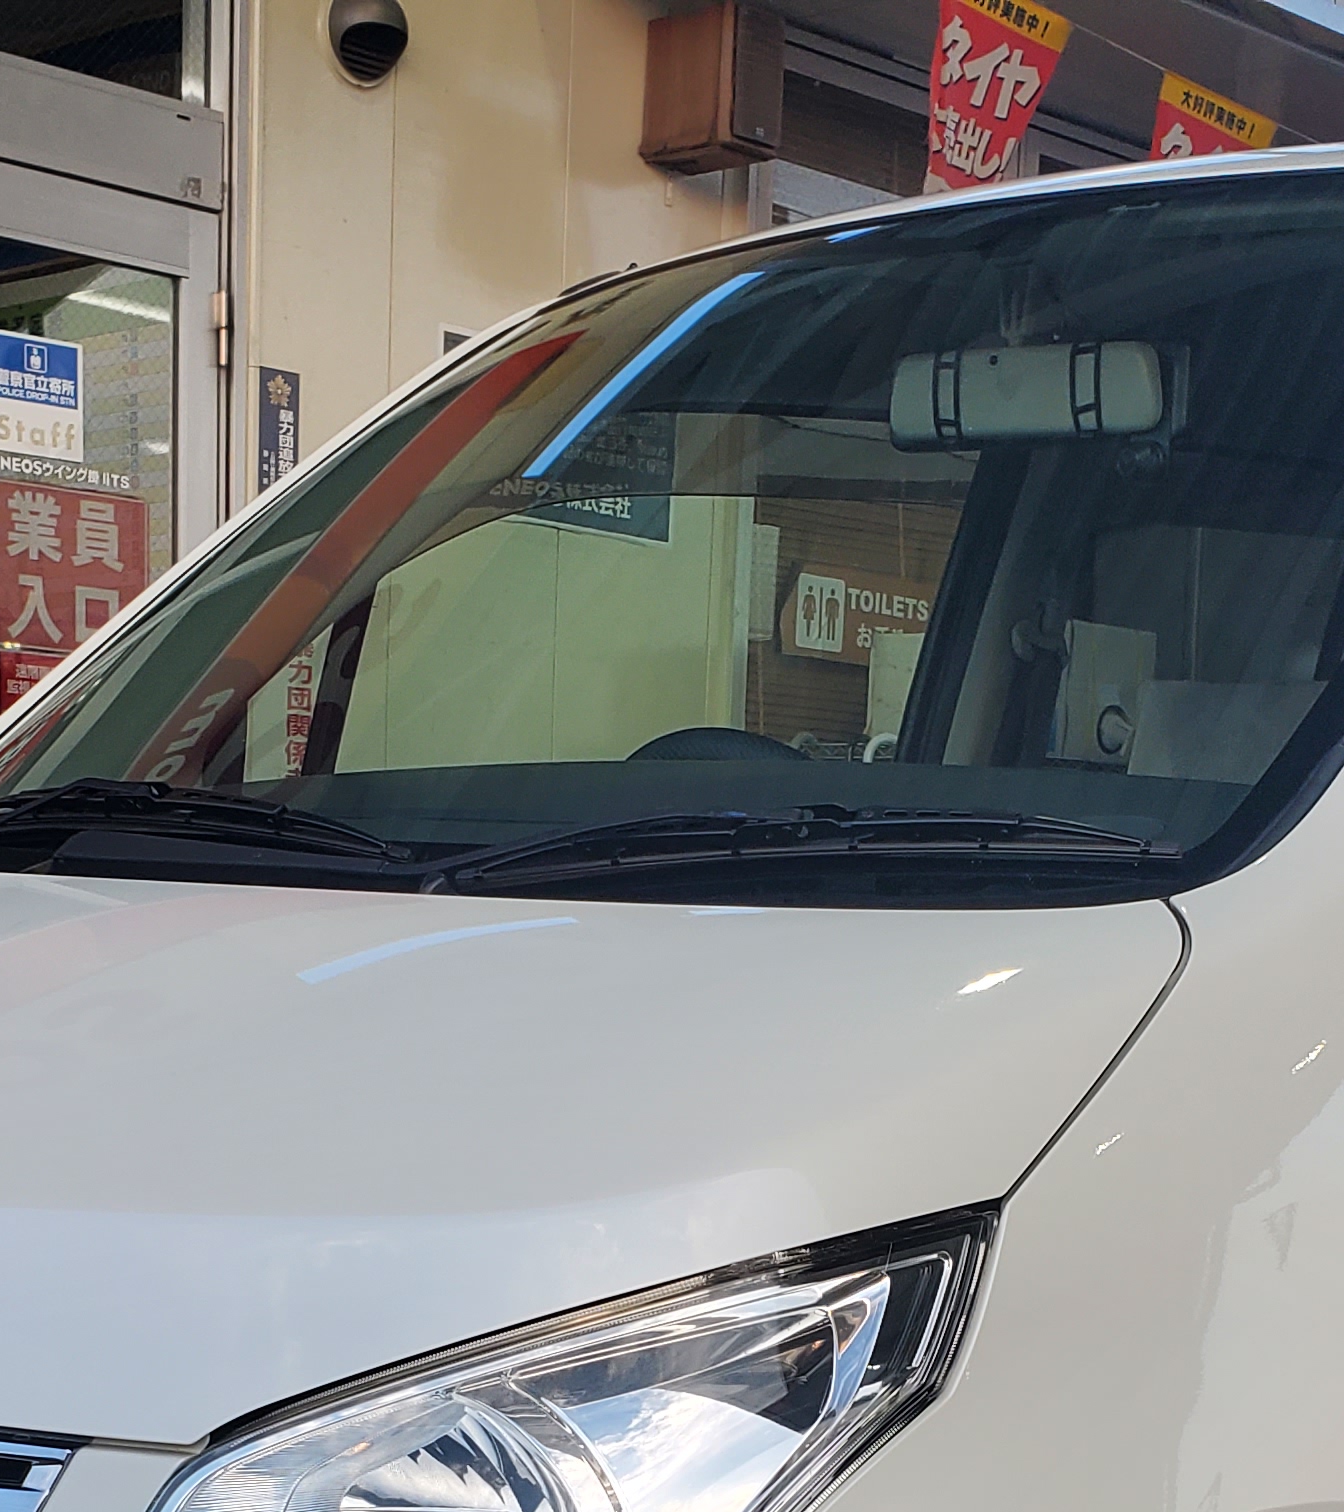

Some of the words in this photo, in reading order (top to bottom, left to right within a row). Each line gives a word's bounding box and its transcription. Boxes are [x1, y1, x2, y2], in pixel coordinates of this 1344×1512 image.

[940, 15, 1042, 120] タイヤ
[846, 587, 930, 622] TOILETS
